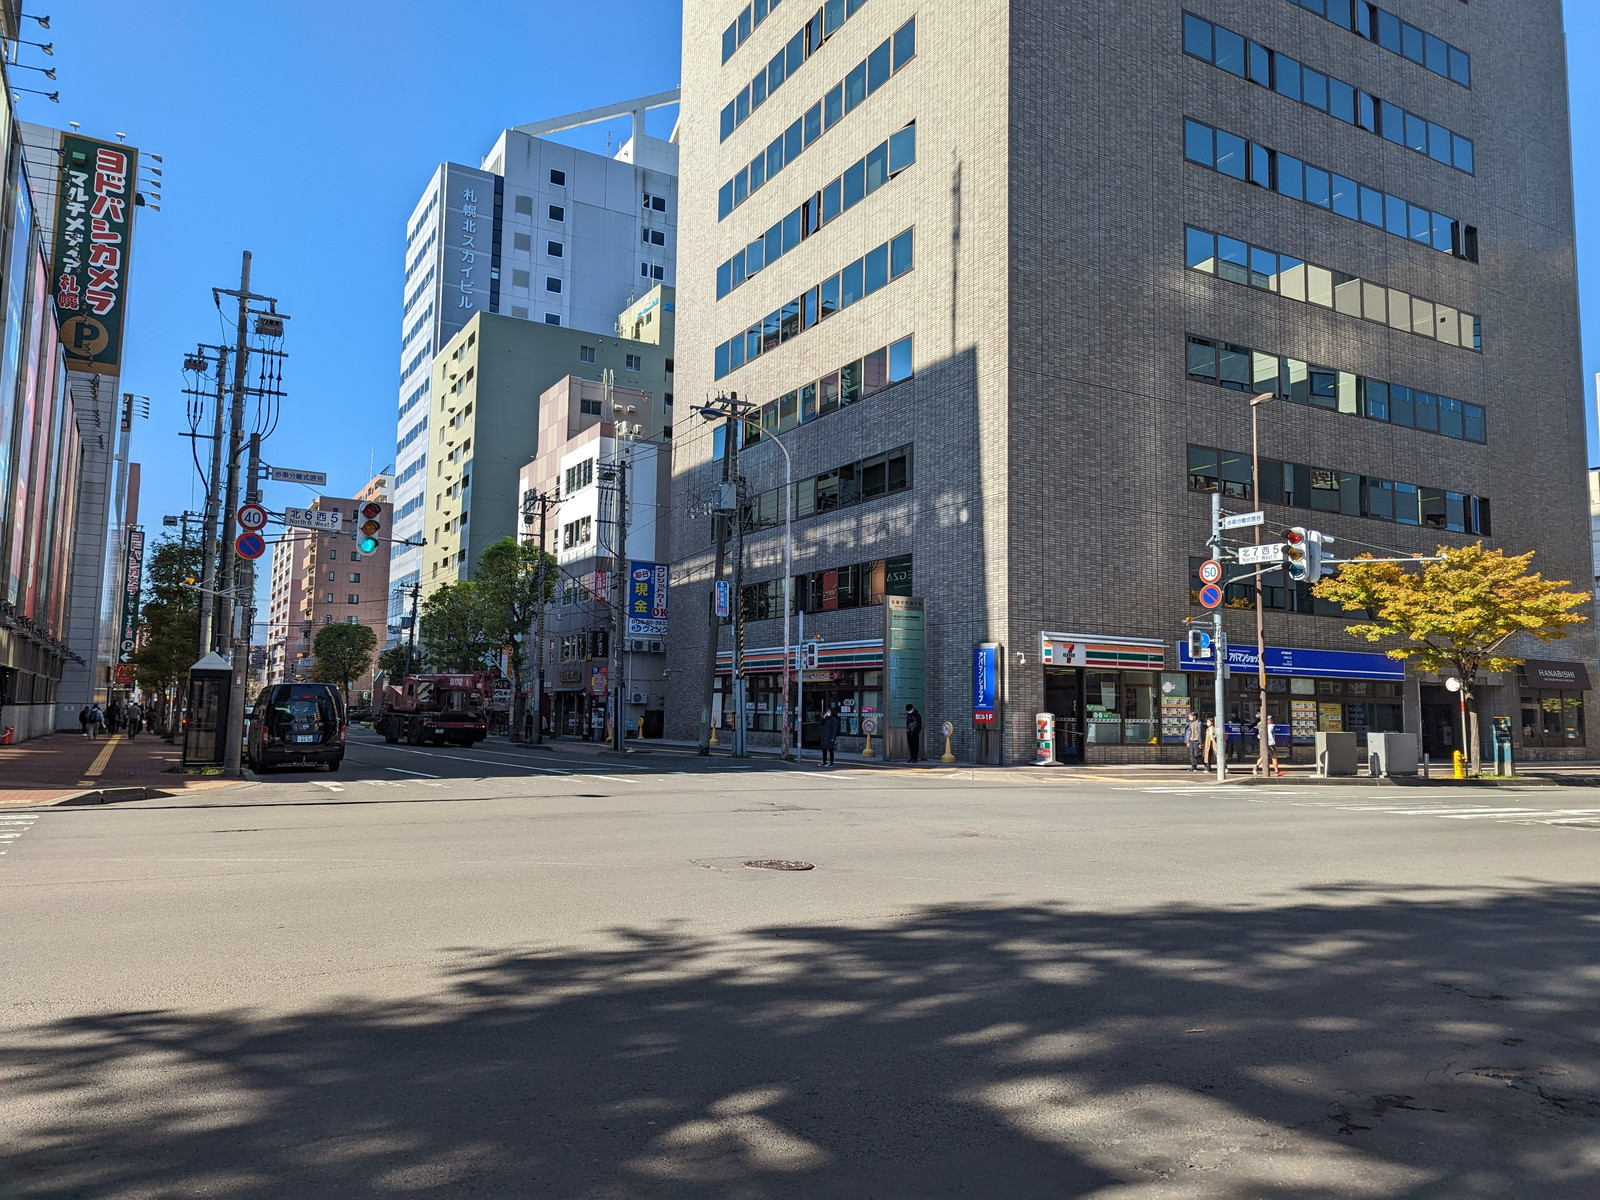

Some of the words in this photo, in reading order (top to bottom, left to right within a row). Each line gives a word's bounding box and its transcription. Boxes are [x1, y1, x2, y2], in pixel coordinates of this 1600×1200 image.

[86, 148, 128, 315] ヨドバシカメラ
[458, 188, 478, 309] 札幌北スカイビル
[74, 321, 100, 349] P
[275, 470, 324, 482] 歩車分離式信号
[244, 511, 261, 524] 40
[1204, 566, 1217, 578] 50
[656, 567, 666, 608] クレジットカード
[634, 582, 648, 613] 現金
[652, 608, 668, 617] OK
[1228, 652, 1259, 663] アパマンショッ
[1538, 669, 1576, 678] HANABISHI
